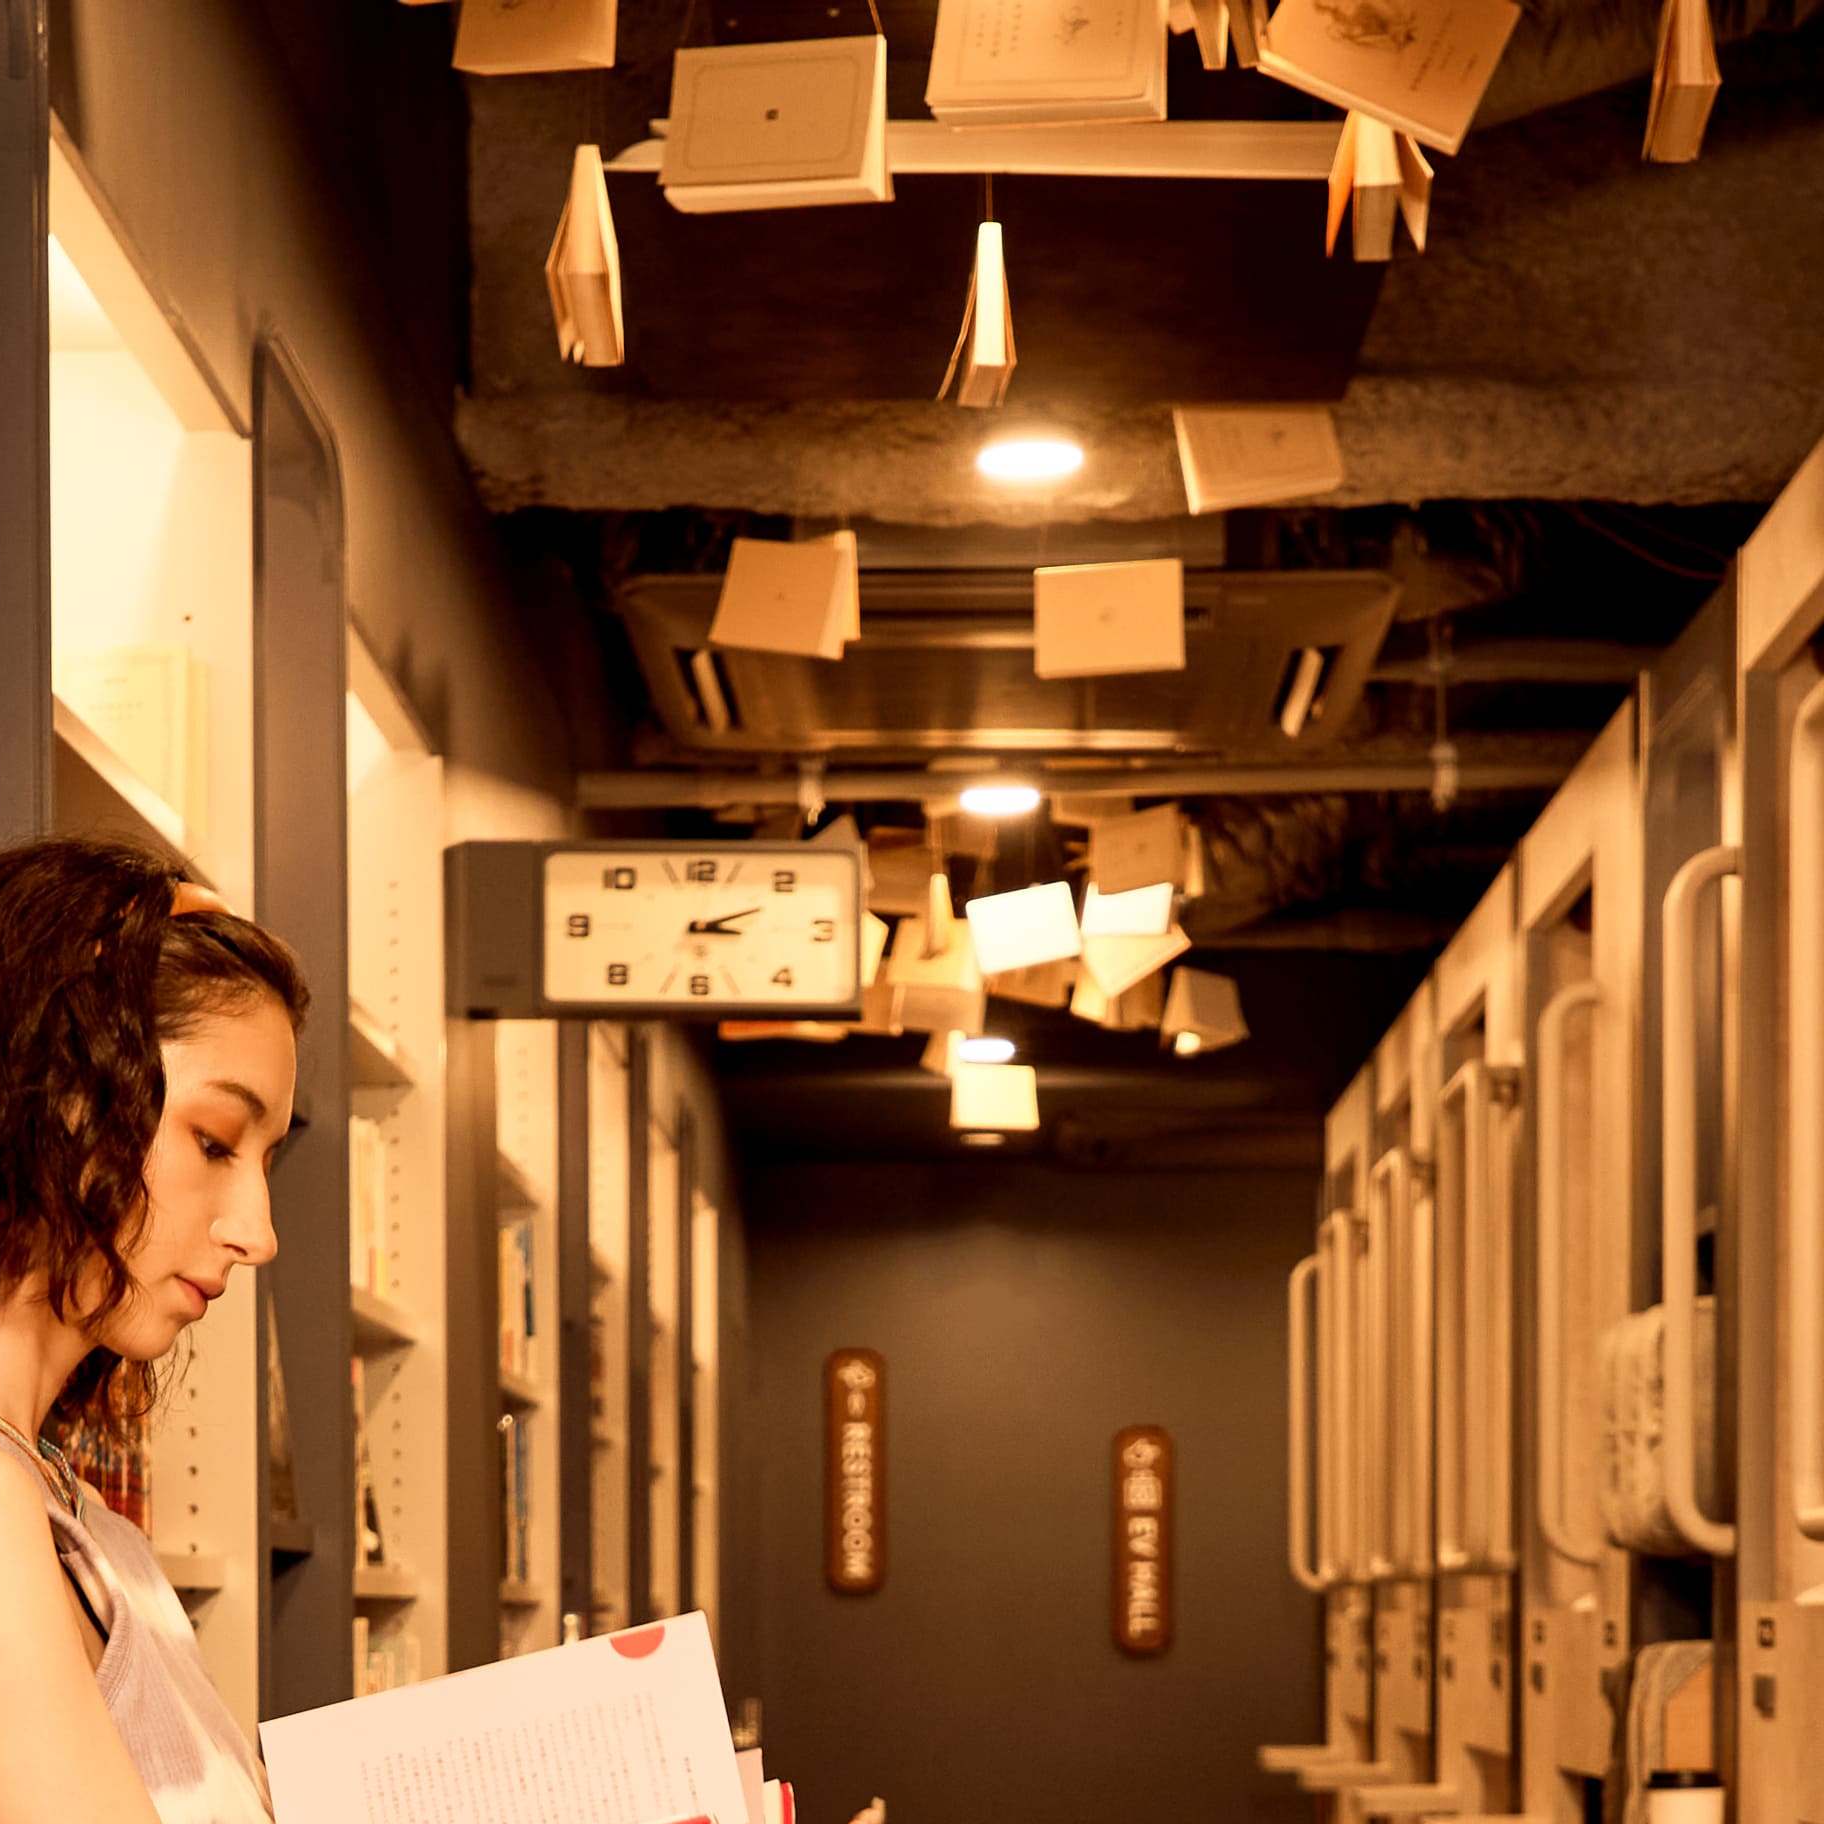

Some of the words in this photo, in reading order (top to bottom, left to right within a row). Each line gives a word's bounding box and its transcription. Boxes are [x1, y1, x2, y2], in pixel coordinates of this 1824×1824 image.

[603, 867, 636, 891] 10
[687, 861, 717, 883] 12
[774, 870, 796, 893] 2
[567, 913, 590, 937] 9
[813, 920, 834, 942] 3
[608, 963, 628, 985] 8
[771, 968, 793, 988] 4
[691, 975, 710, 996] 6
